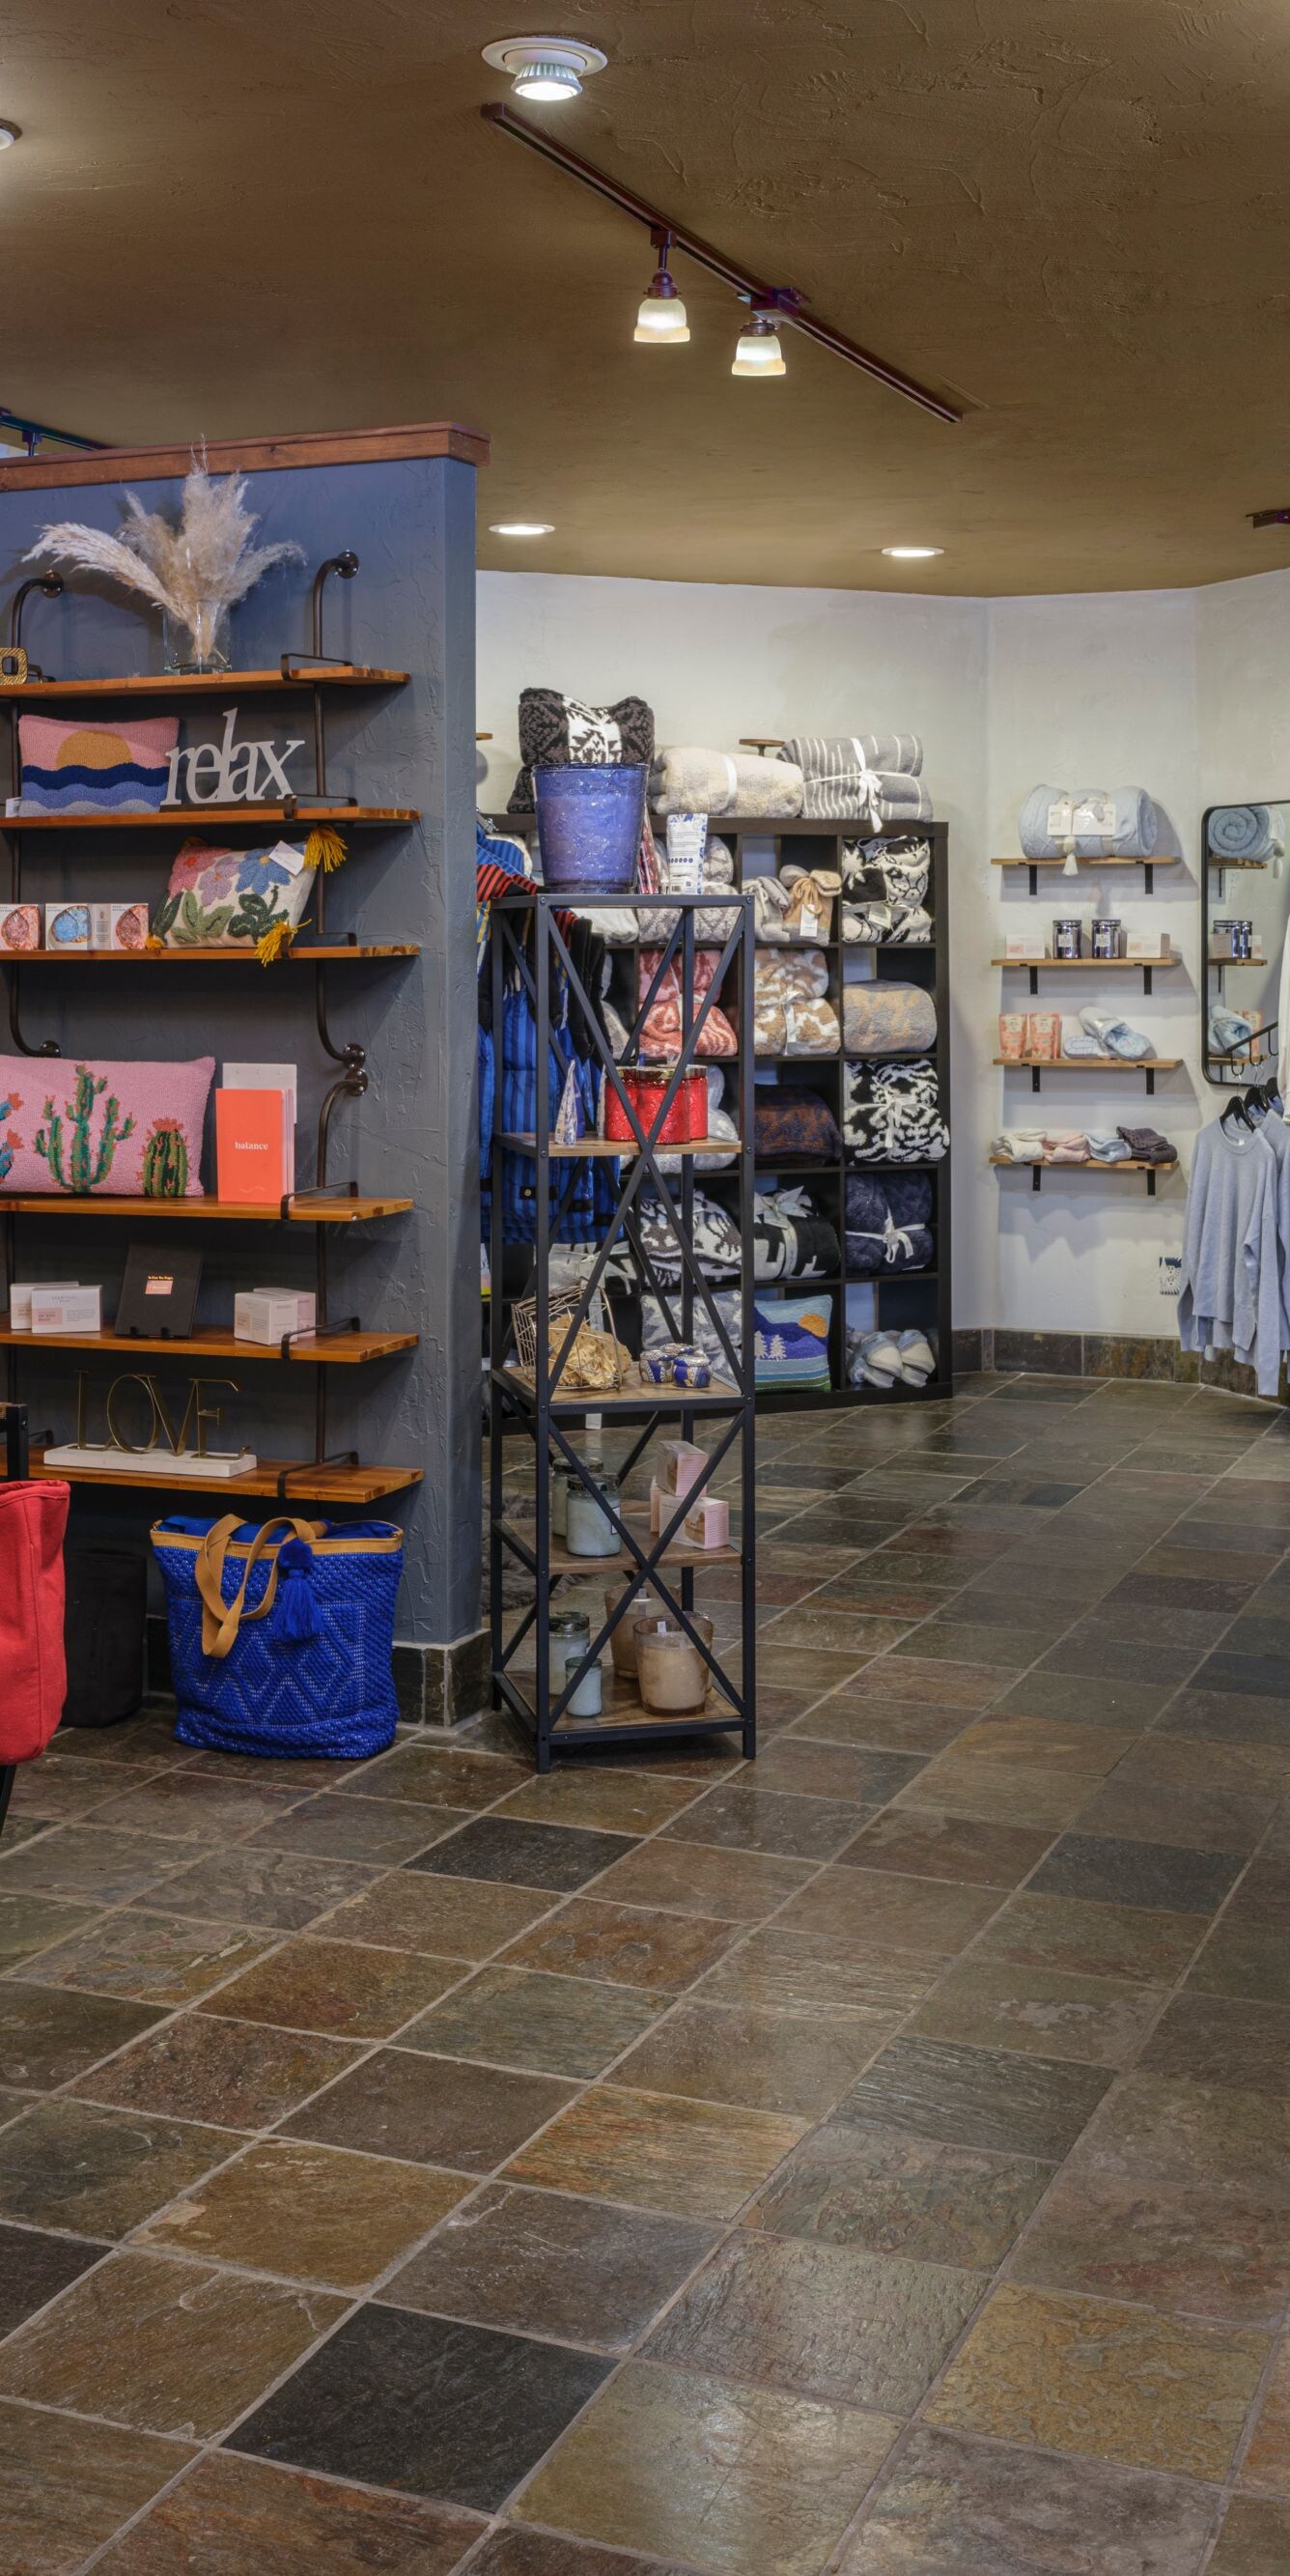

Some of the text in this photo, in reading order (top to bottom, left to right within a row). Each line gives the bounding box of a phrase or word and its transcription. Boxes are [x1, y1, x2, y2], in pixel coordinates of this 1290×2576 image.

[159, 707, 305, 806] relax
[235, 1141, 268, 1150] balance
[68, 1369, 250, 1460] LOVE
